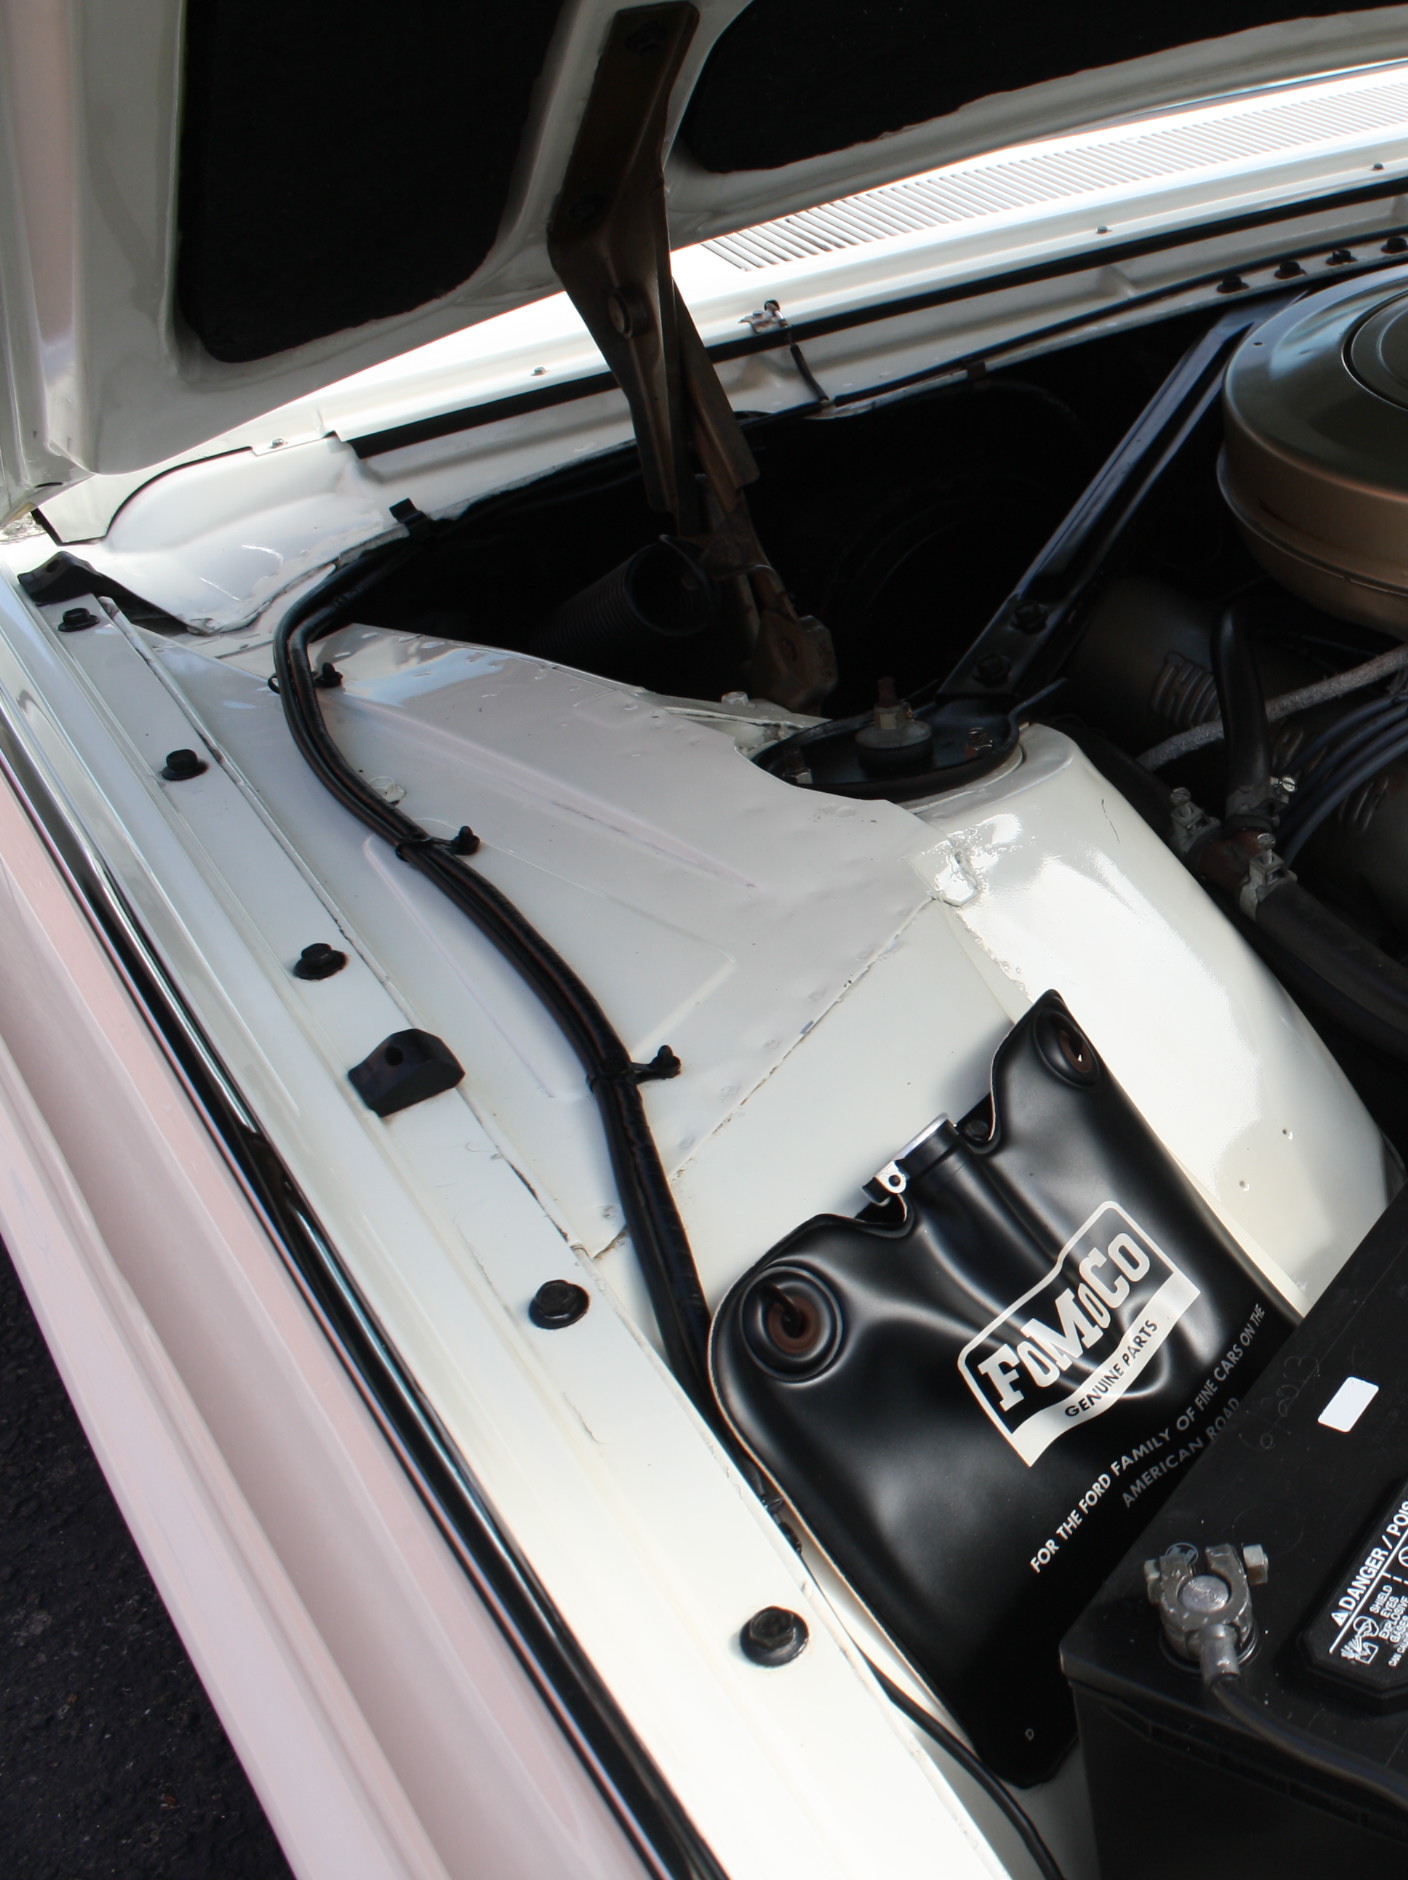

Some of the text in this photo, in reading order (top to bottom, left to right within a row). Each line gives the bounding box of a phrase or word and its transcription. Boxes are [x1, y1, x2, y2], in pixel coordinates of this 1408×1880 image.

[1064, 1318, 1158, 1418] GENUINE PARTS
[1030, 1302, 1266, 1574] FOR THE FORD FAMILY OF FINE CARS ON THE
[1122, 1396, 1240, 1508] AMERICAN ROAD
[1338, 1548, 1388, 1612] DANGER
[1370, 1585, 1392, 1614] SHIELD
[1380, 1596, 1399, 1618] EYES
[1388, 1653, 1402, 1666] CAN
